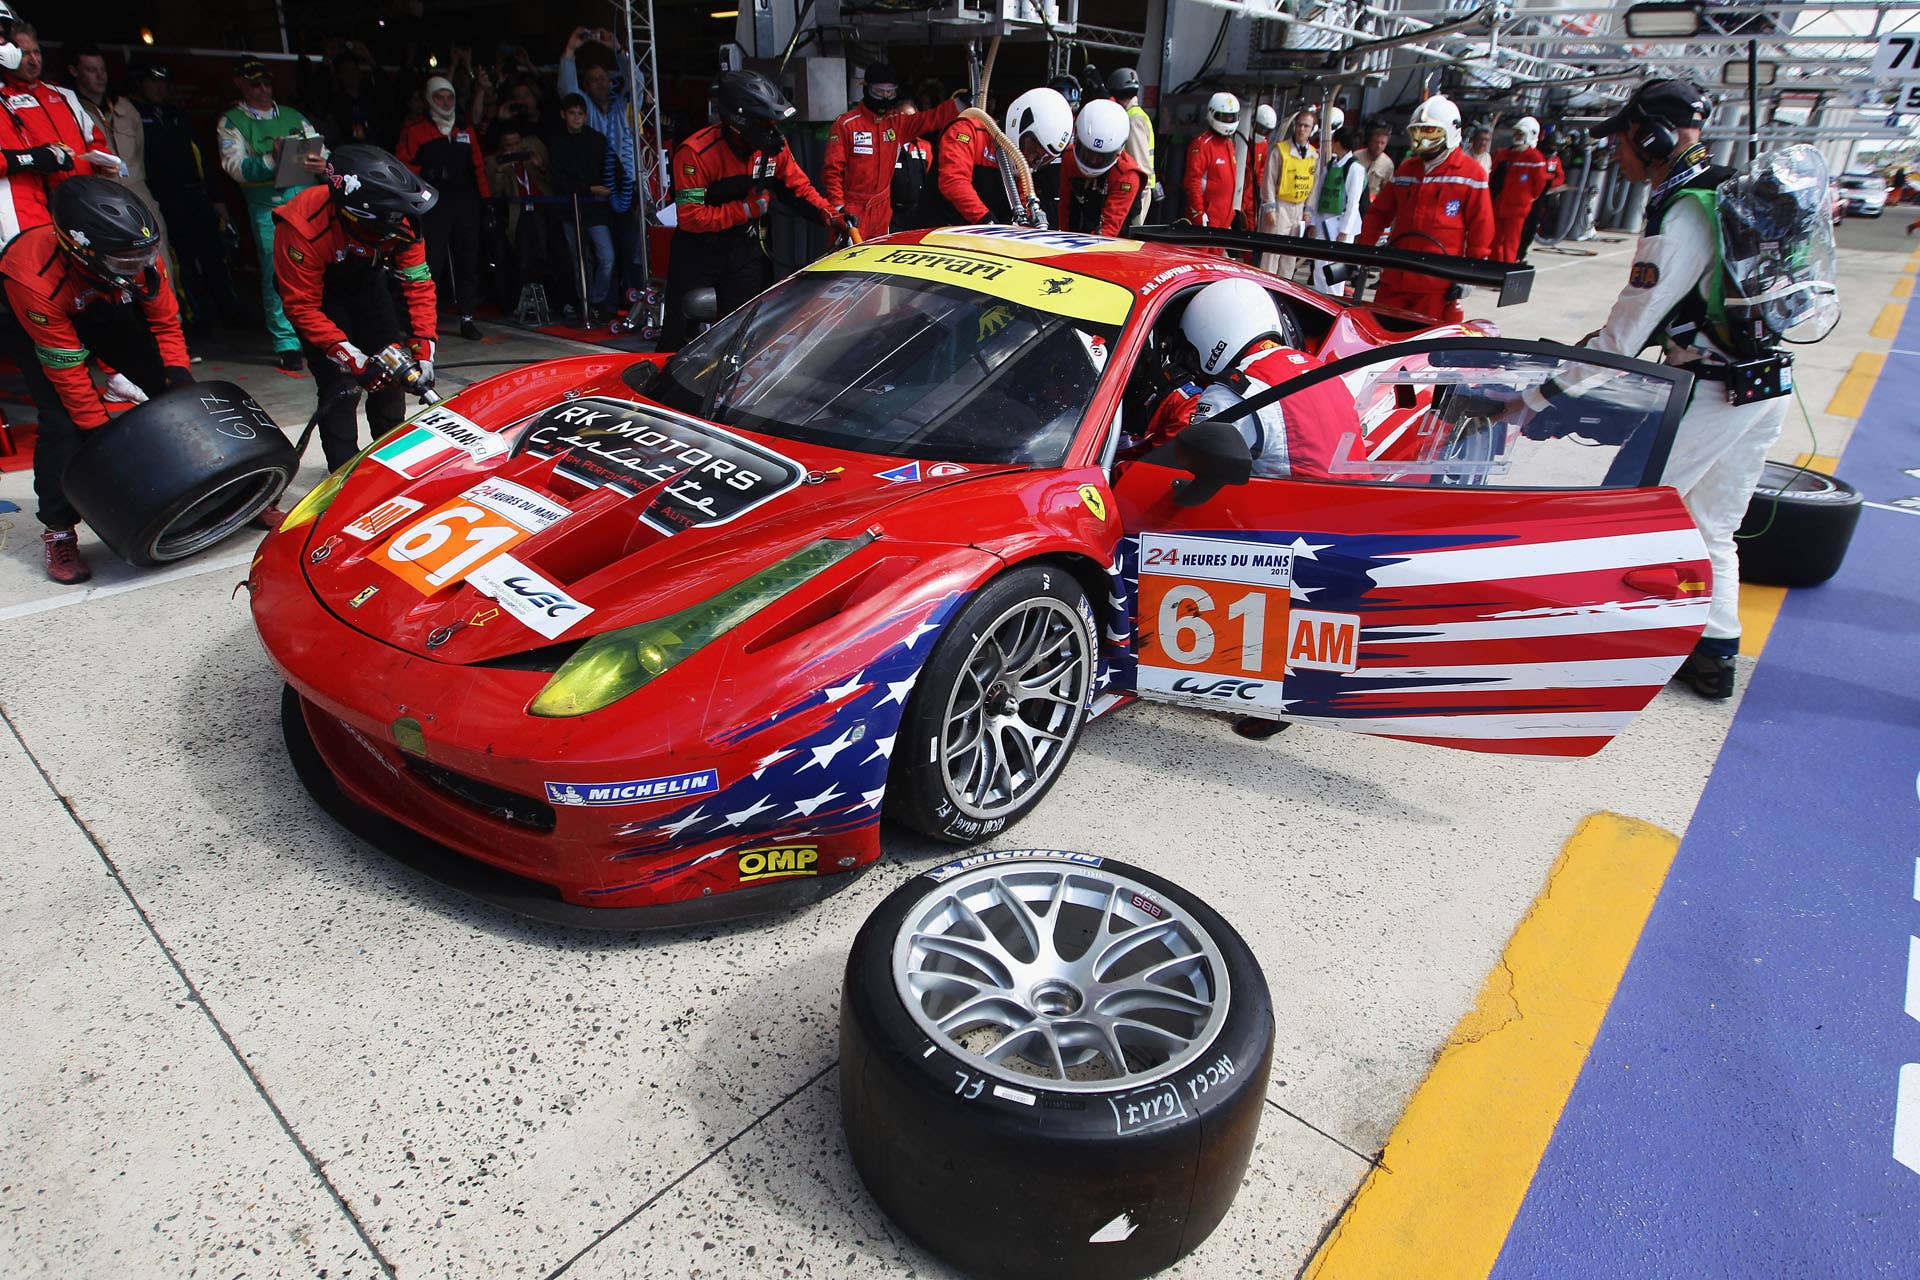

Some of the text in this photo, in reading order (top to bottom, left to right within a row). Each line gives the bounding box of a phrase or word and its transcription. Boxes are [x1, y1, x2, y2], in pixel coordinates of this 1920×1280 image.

[1888, 38, 1920, 69] 7
[875, 249, 1013, 281] Ferrari
[1632, 265, 1656, 285] FIA
[200, 393, 256, 440] 6117
[420, 413, 447, 425] LE
[554, 406, 763, 493] RK MOTORS
[350, 502, 413, 535] AM
[471, 485, 562, 521] 24 HEURES DU MANS
[387, 506, 520, 587] 61
[1144, 548, 1290, 568] 24 HEURES DU MANS
[1270, 568, 1289, 576] 2012
[503, 576, 578, 618] WEC
[1158, 584, 1267, 673] 61
[1290, 619, 1355, 665] AM
[1172, 676, 1264, 701] WEC
[589, 774, 709, 801] MICHELIN
[738, 849, 818, 874] OMP
[960, 850, 1096, 867] MICHELIN
[1132, 896, 1162, 917] BBS
[954, 1054, 1236, 1126] FL 6117 AFC61
